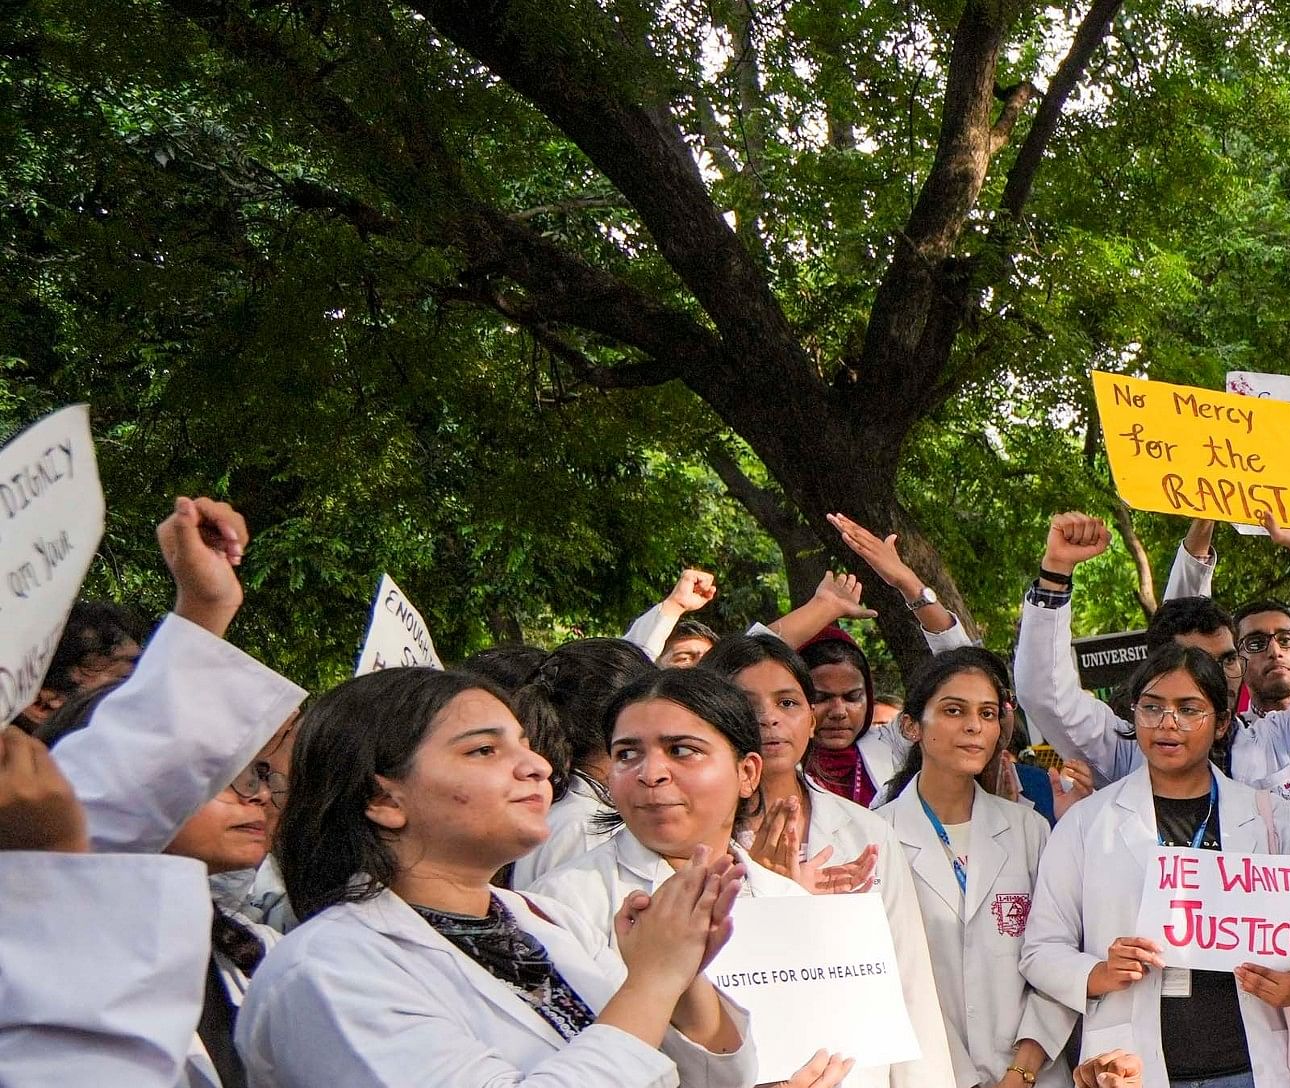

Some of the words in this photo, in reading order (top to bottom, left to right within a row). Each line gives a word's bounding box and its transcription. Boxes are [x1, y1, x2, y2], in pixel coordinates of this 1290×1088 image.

[1113, 383, 1147, 408] No
[1173, 391, 1254, 434] Mercy
[1119, 423, 1178, 462] for
[1203, 435, 1265, 473] the
[1081, 645, 1148, 669] UNIVERSIT
[1158, 855, 1200, 889] WE
[771, 969, 798, 984] FOR
[800, 967, 826, 982] OUR
[828, 961, 887, 980] HEALERS!
